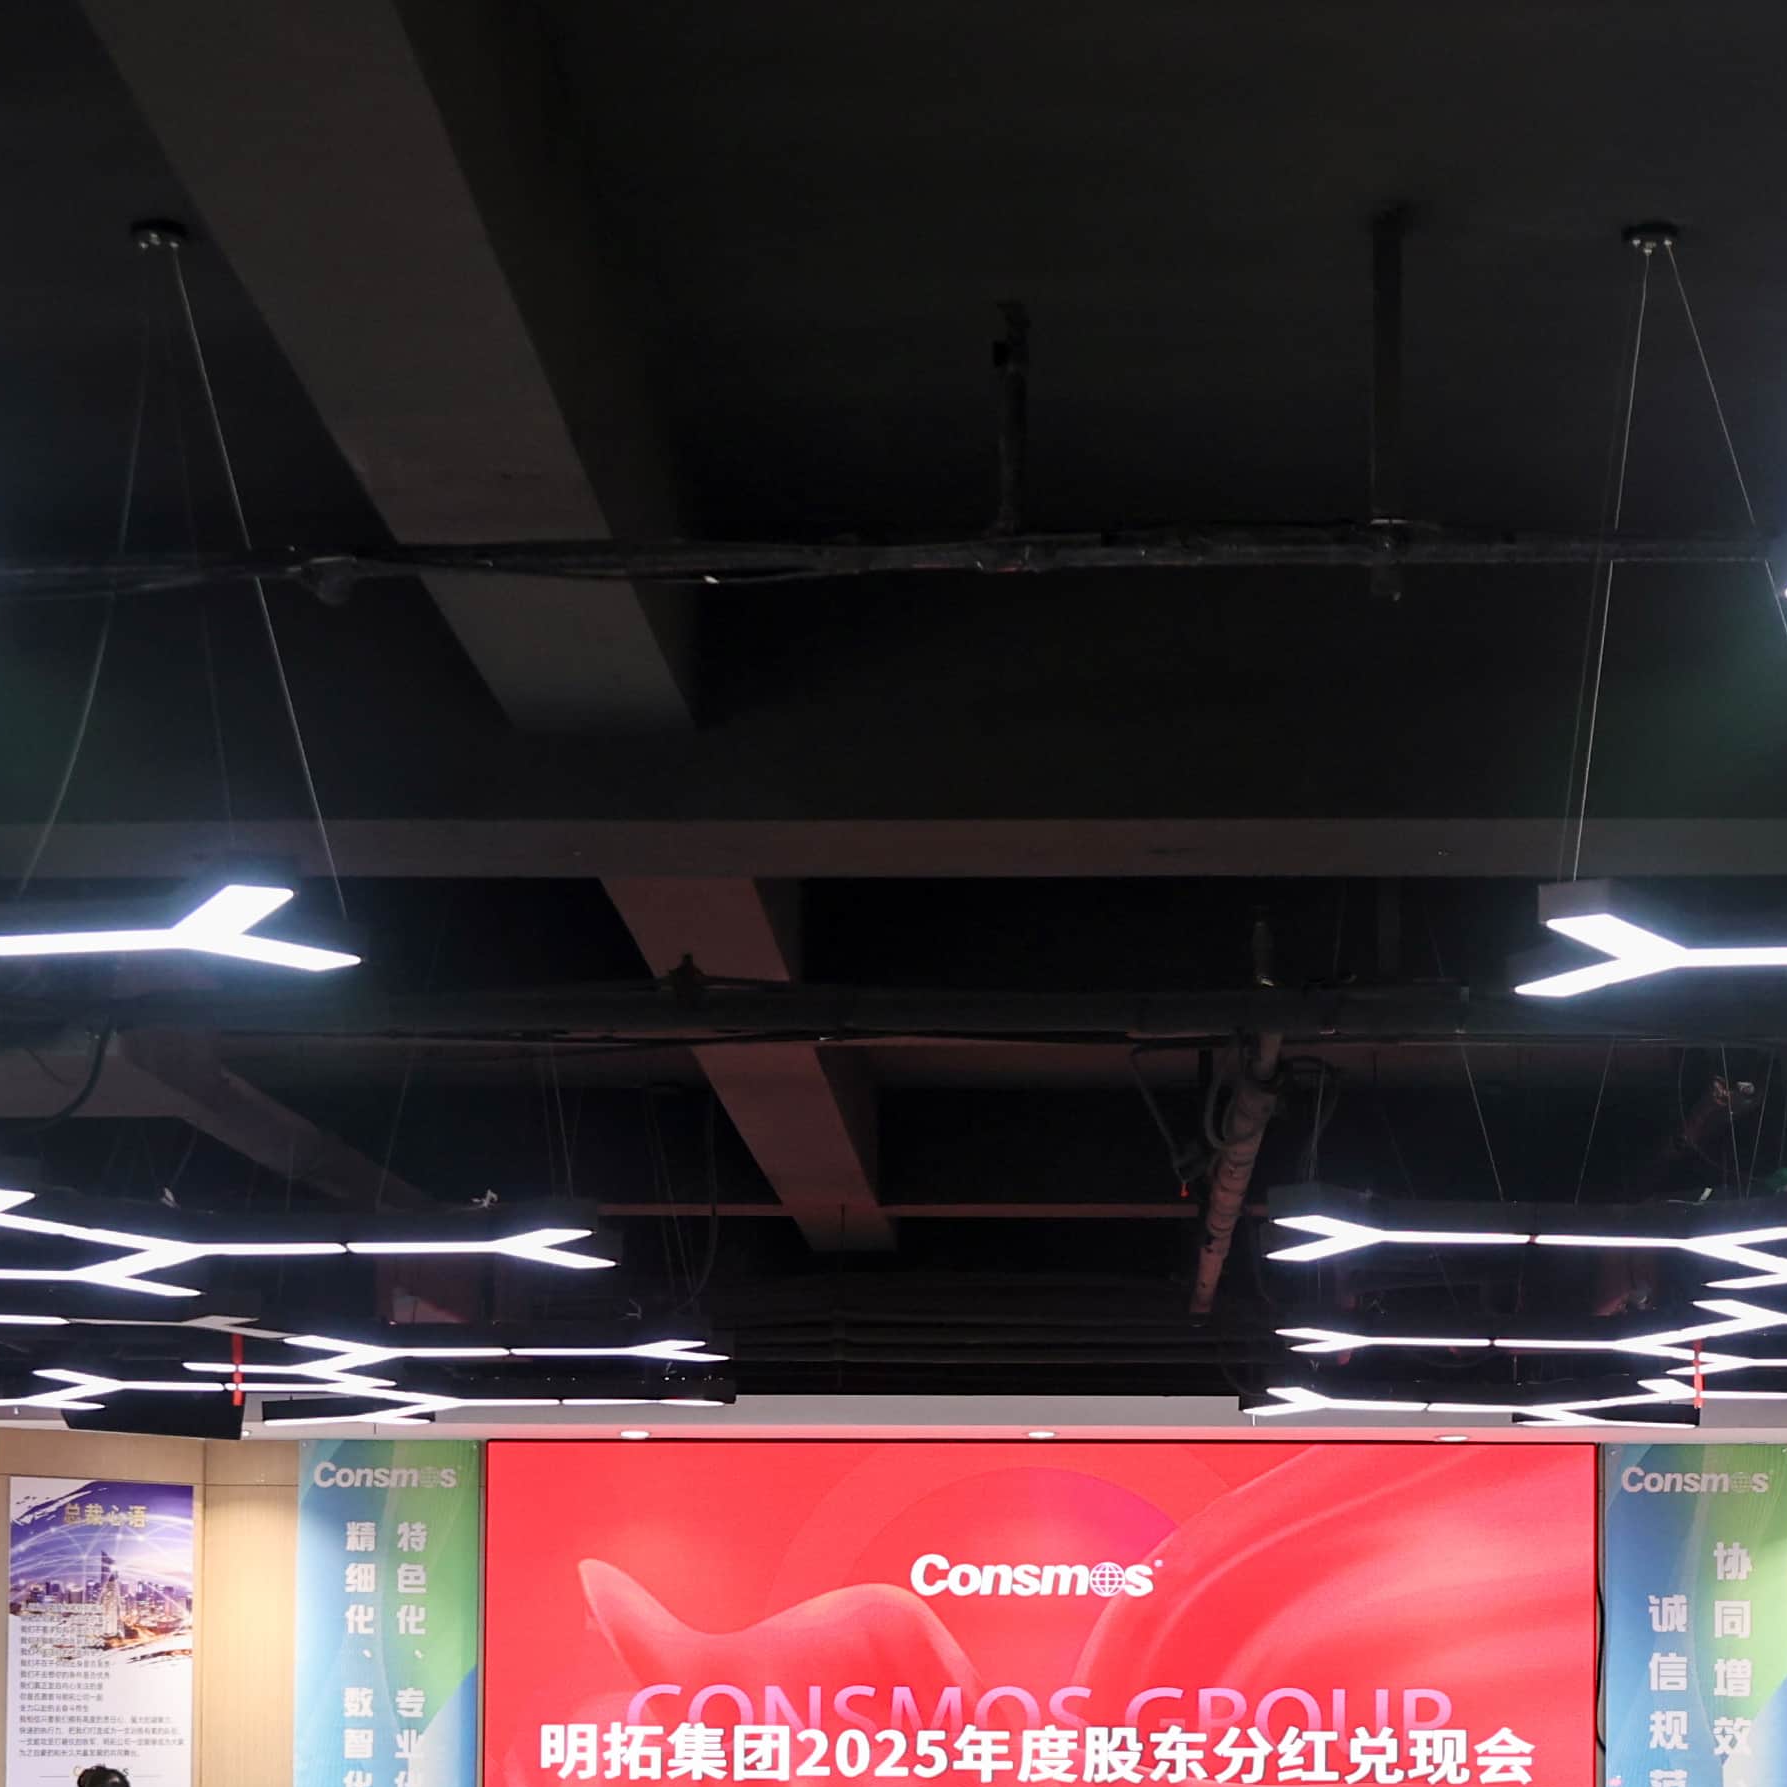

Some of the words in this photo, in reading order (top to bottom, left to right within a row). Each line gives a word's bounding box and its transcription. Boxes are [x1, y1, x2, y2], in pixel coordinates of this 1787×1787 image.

[313, 1462, 459, 1490] Consmos
[1621, 1466, 1770, 1494] Consmos
[910, 1554, 1163, 1598] Consmos
[539, 1722, 1536, 1786] 明拓集团2025年度股东分红兑现会
